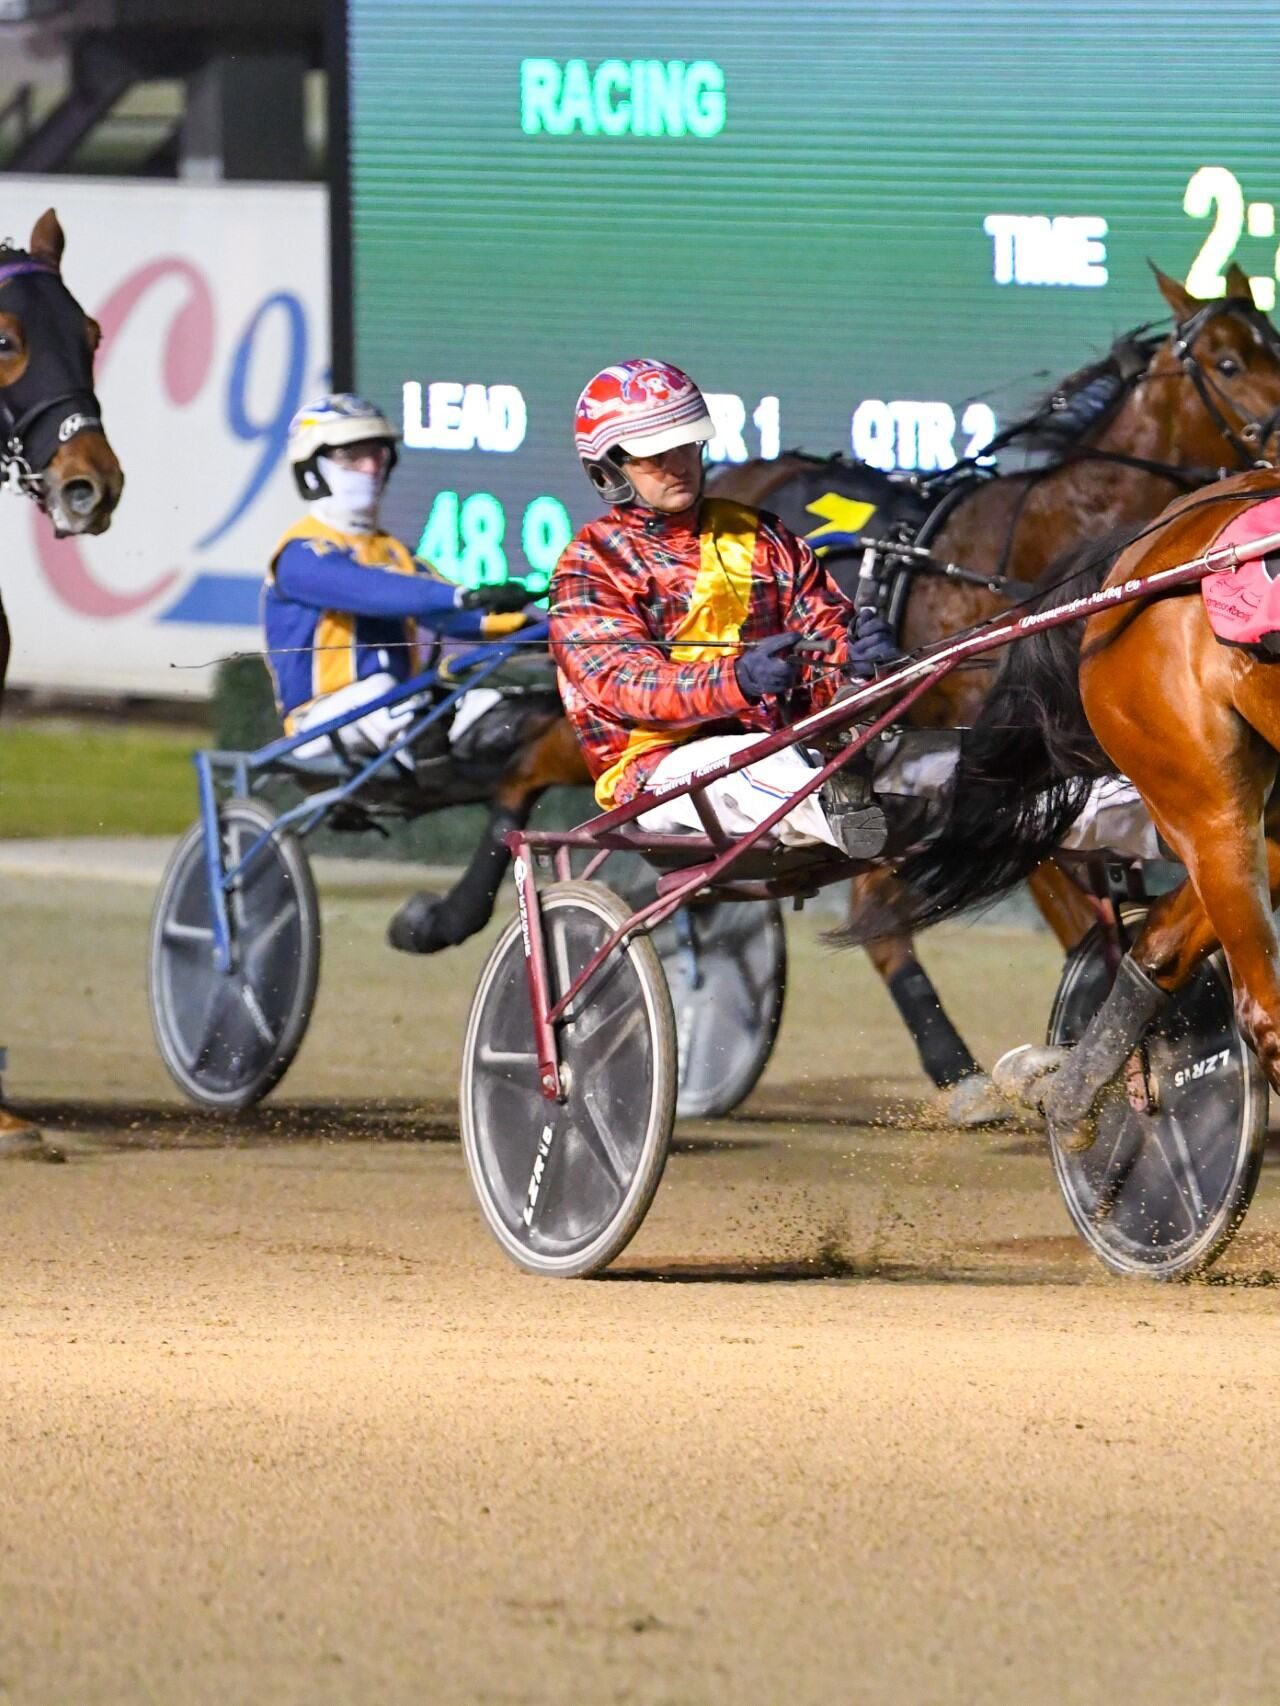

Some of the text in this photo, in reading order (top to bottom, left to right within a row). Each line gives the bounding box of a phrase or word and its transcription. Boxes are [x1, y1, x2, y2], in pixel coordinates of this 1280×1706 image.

[519, 58, 726, 138] RACING
[984, 215, 1107, 286] TIME
[403, 381, 526, 452] LEAD
[753, 396, 780, 460] 1
[852, 400, 996, 472] QTR 2
